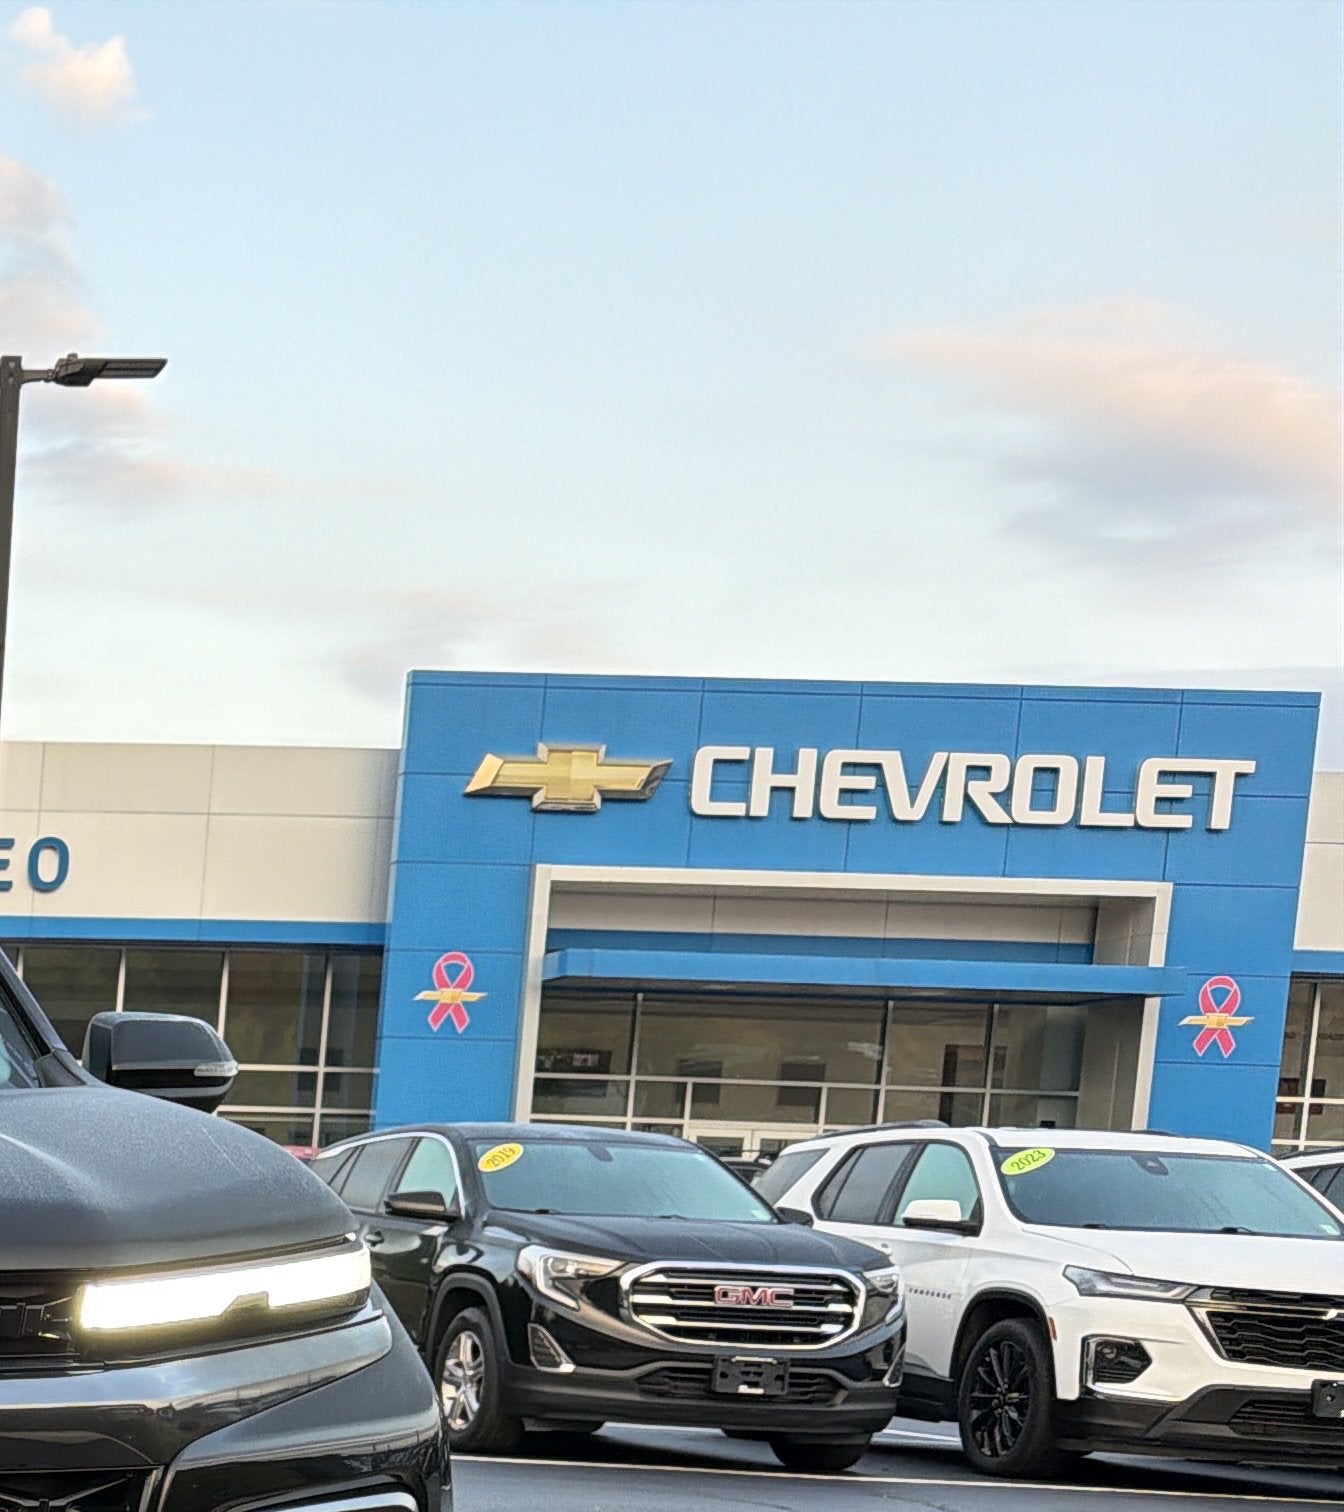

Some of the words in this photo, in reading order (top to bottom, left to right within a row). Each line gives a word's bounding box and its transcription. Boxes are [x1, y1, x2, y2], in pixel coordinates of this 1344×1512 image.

[691, 745, 1256, 831] CHEVROLET
[485, 1147, 517, 1168] 2019
[1010, 1149, 1047, 1171] 2023
[714, 1285, 795, 1308] GMC
